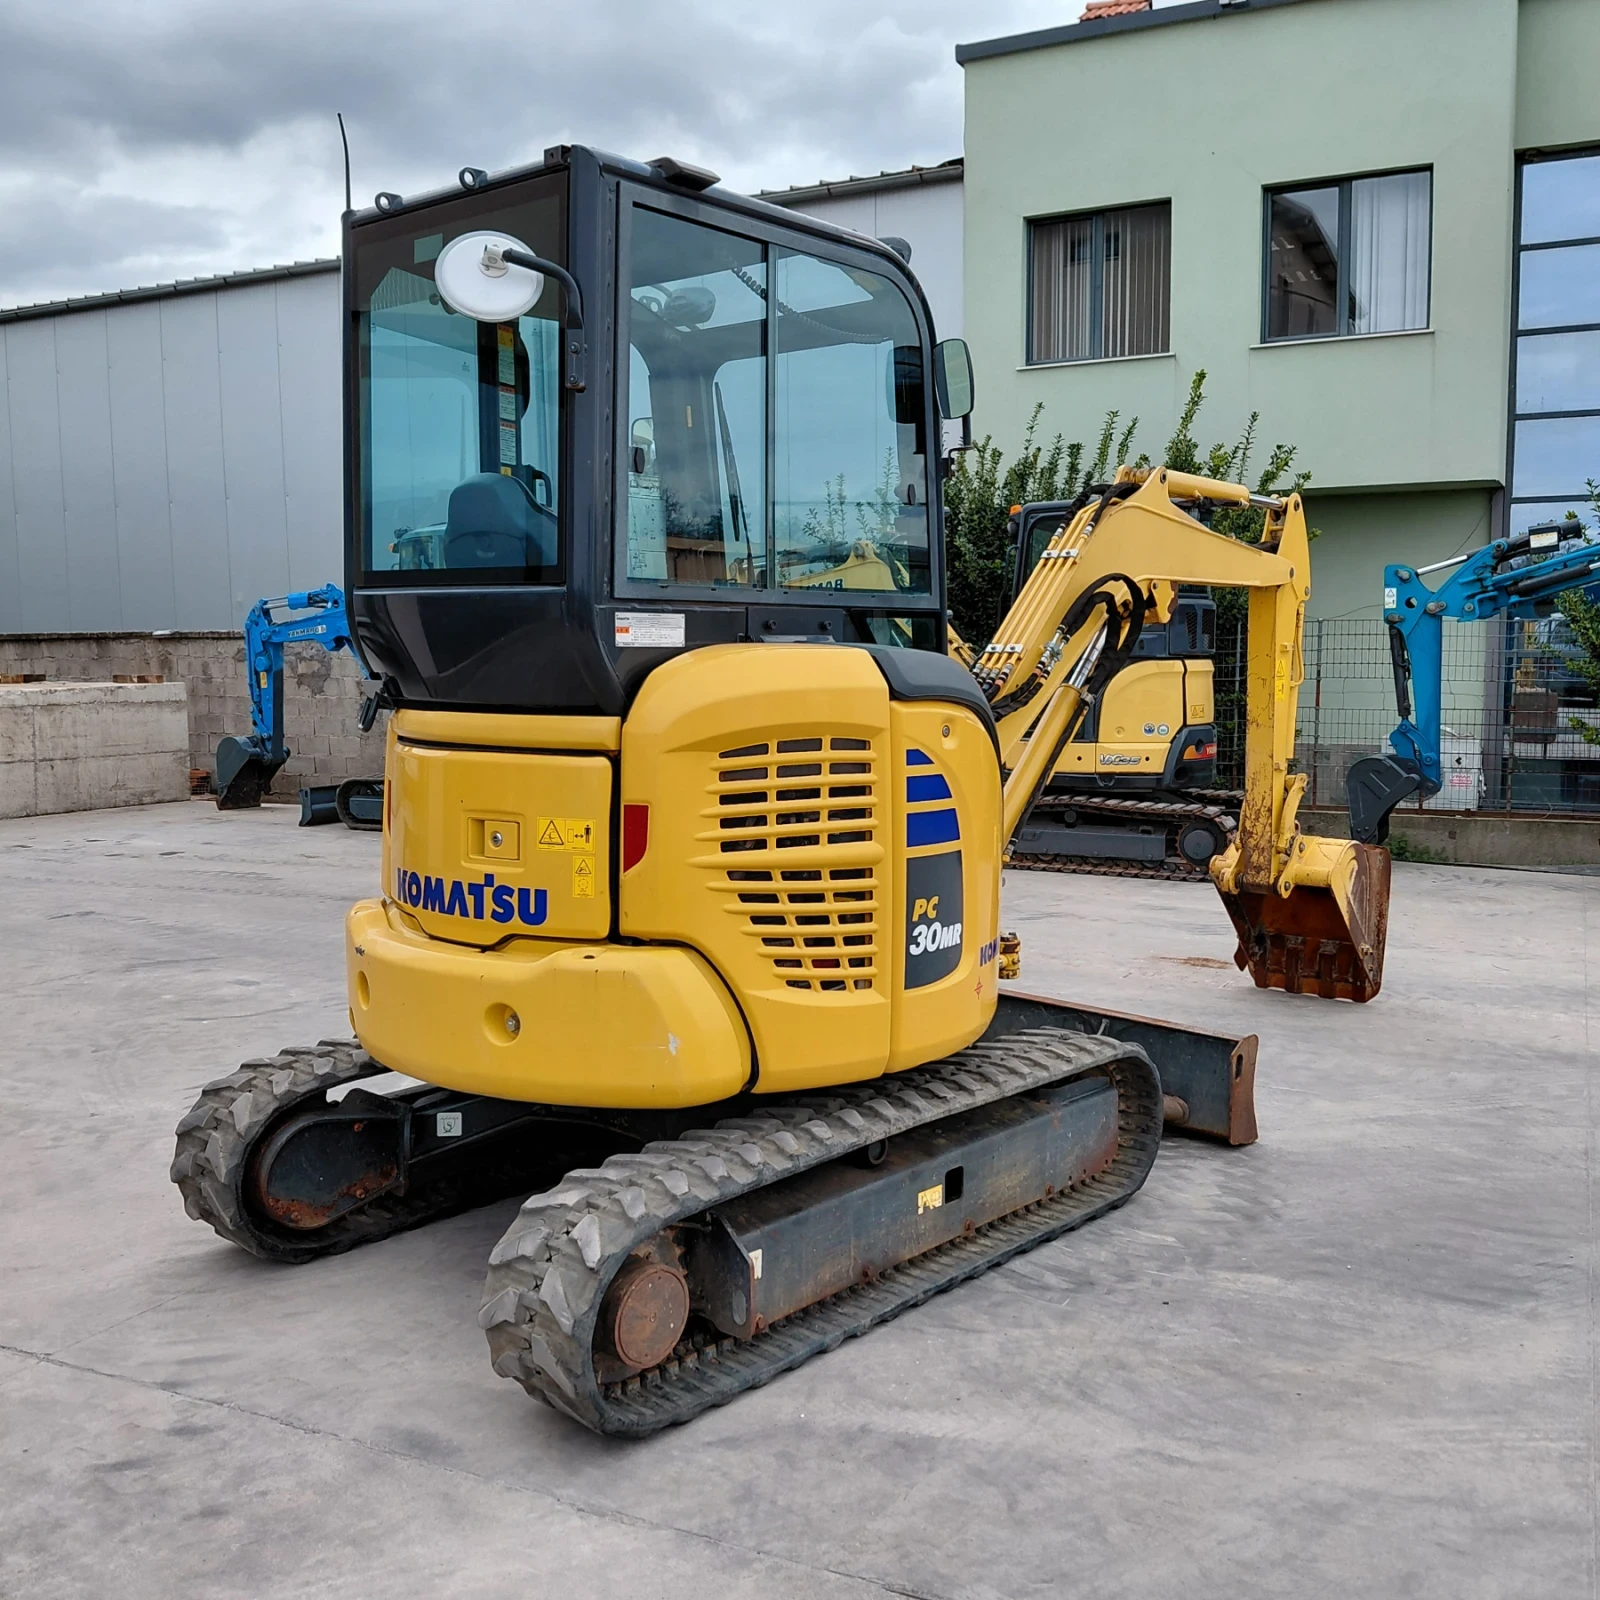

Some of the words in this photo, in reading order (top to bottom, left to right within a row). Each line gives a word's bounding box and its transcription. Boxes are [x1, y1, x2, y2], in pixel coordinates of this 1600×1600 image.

[397, 867, 548, 926] KOMATSU
[912, 896, 939, 922] PC
[909, 921, 962, 956] 30MR
